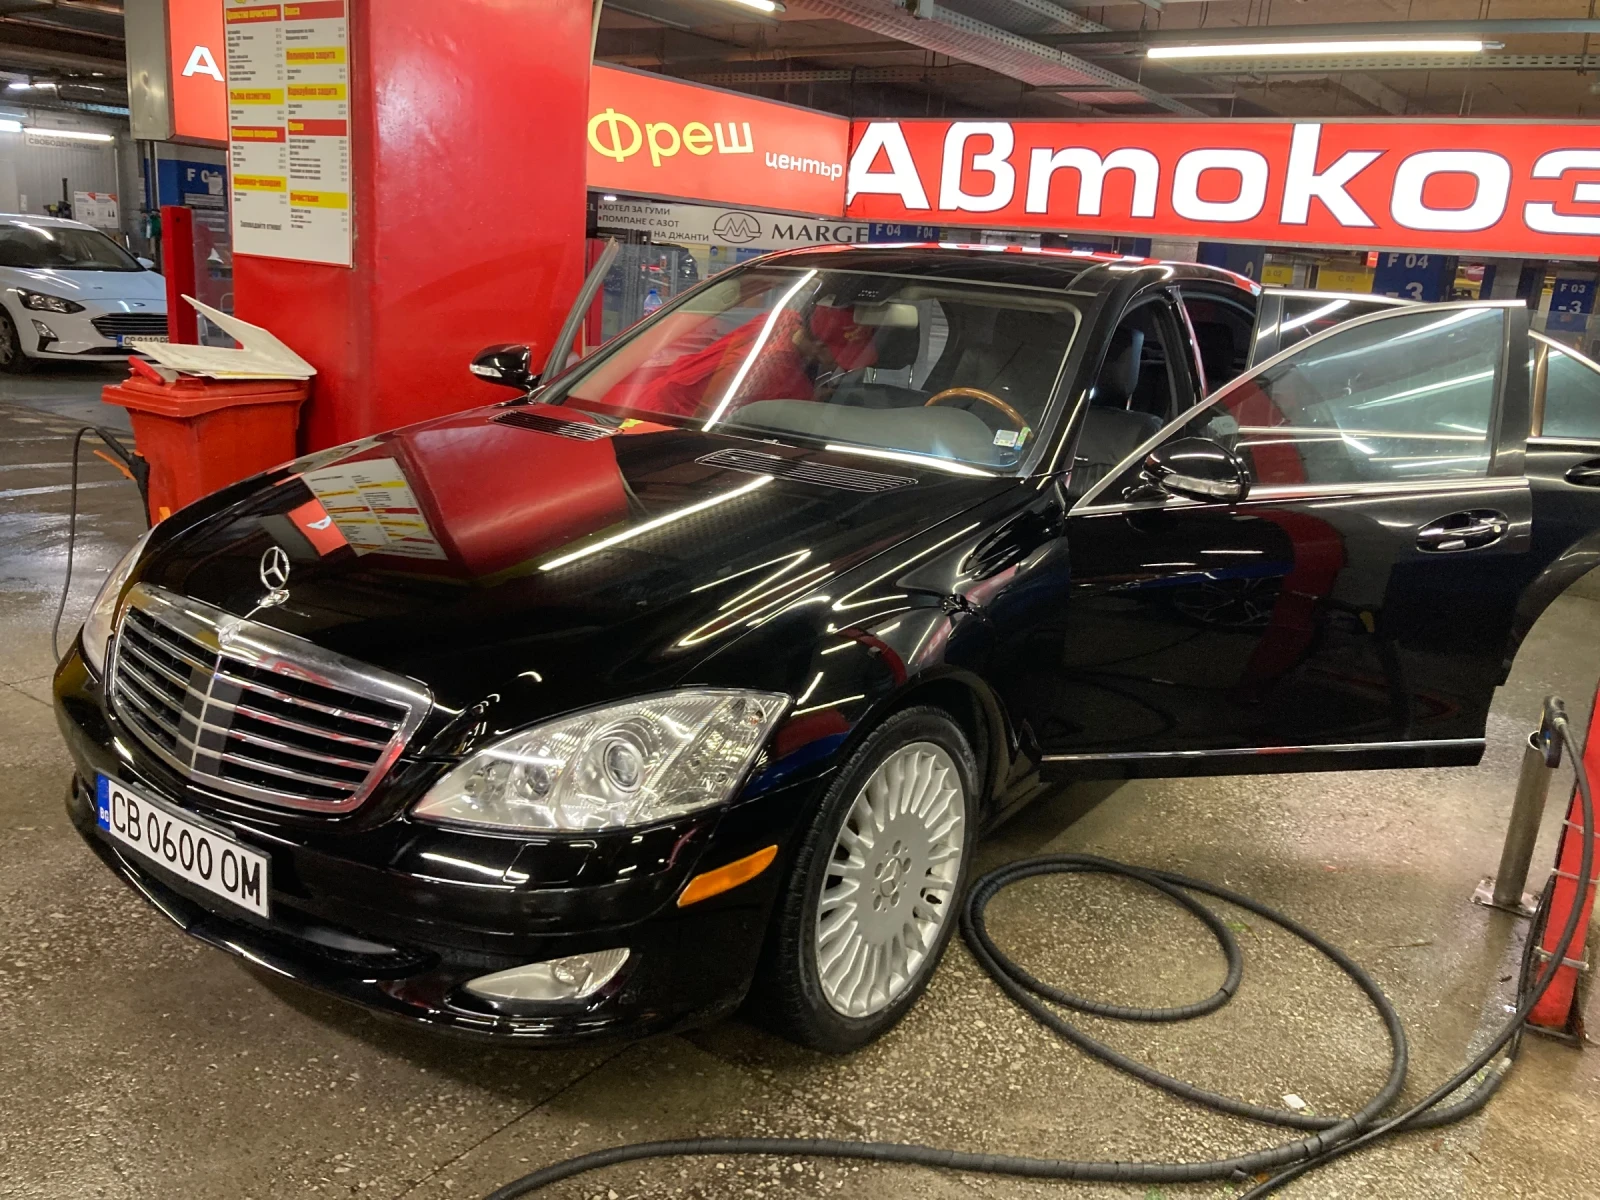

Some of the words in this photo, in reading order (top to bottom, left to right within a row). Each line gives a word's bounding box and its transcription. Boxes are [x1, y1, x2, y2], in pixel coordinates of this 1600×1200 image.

[587, 108, 754, 167] Фреш
[187, 168, 196, 181] F
[602, 204, 630, 213] ХОТЕЛ
[645, 206, 671, 215] ГУМИ
[602, 214, 646, 225] ПОМПАНЕ
[656, 219, 680, 228] АЗОТ
[654, 230, 667, 238] НА
[668, 231, 709, 241] ДЖАНТИ
[876, 225, 882, 235] F
[886, 224, 901, 236] 04
[917, 228, 922, 237] F
[1387, 254, 1397, 267] F
[1405, 254, 1428, 269] 04
[1560, 283, 1568, 292] F
[1571, 284, 1586, 293] 03
[99, 806, 109, 823] BG
[112, 791, 141, 842] CB
[147, 812, 213, 880] 0600
[221, 849, 261, 906] OM
